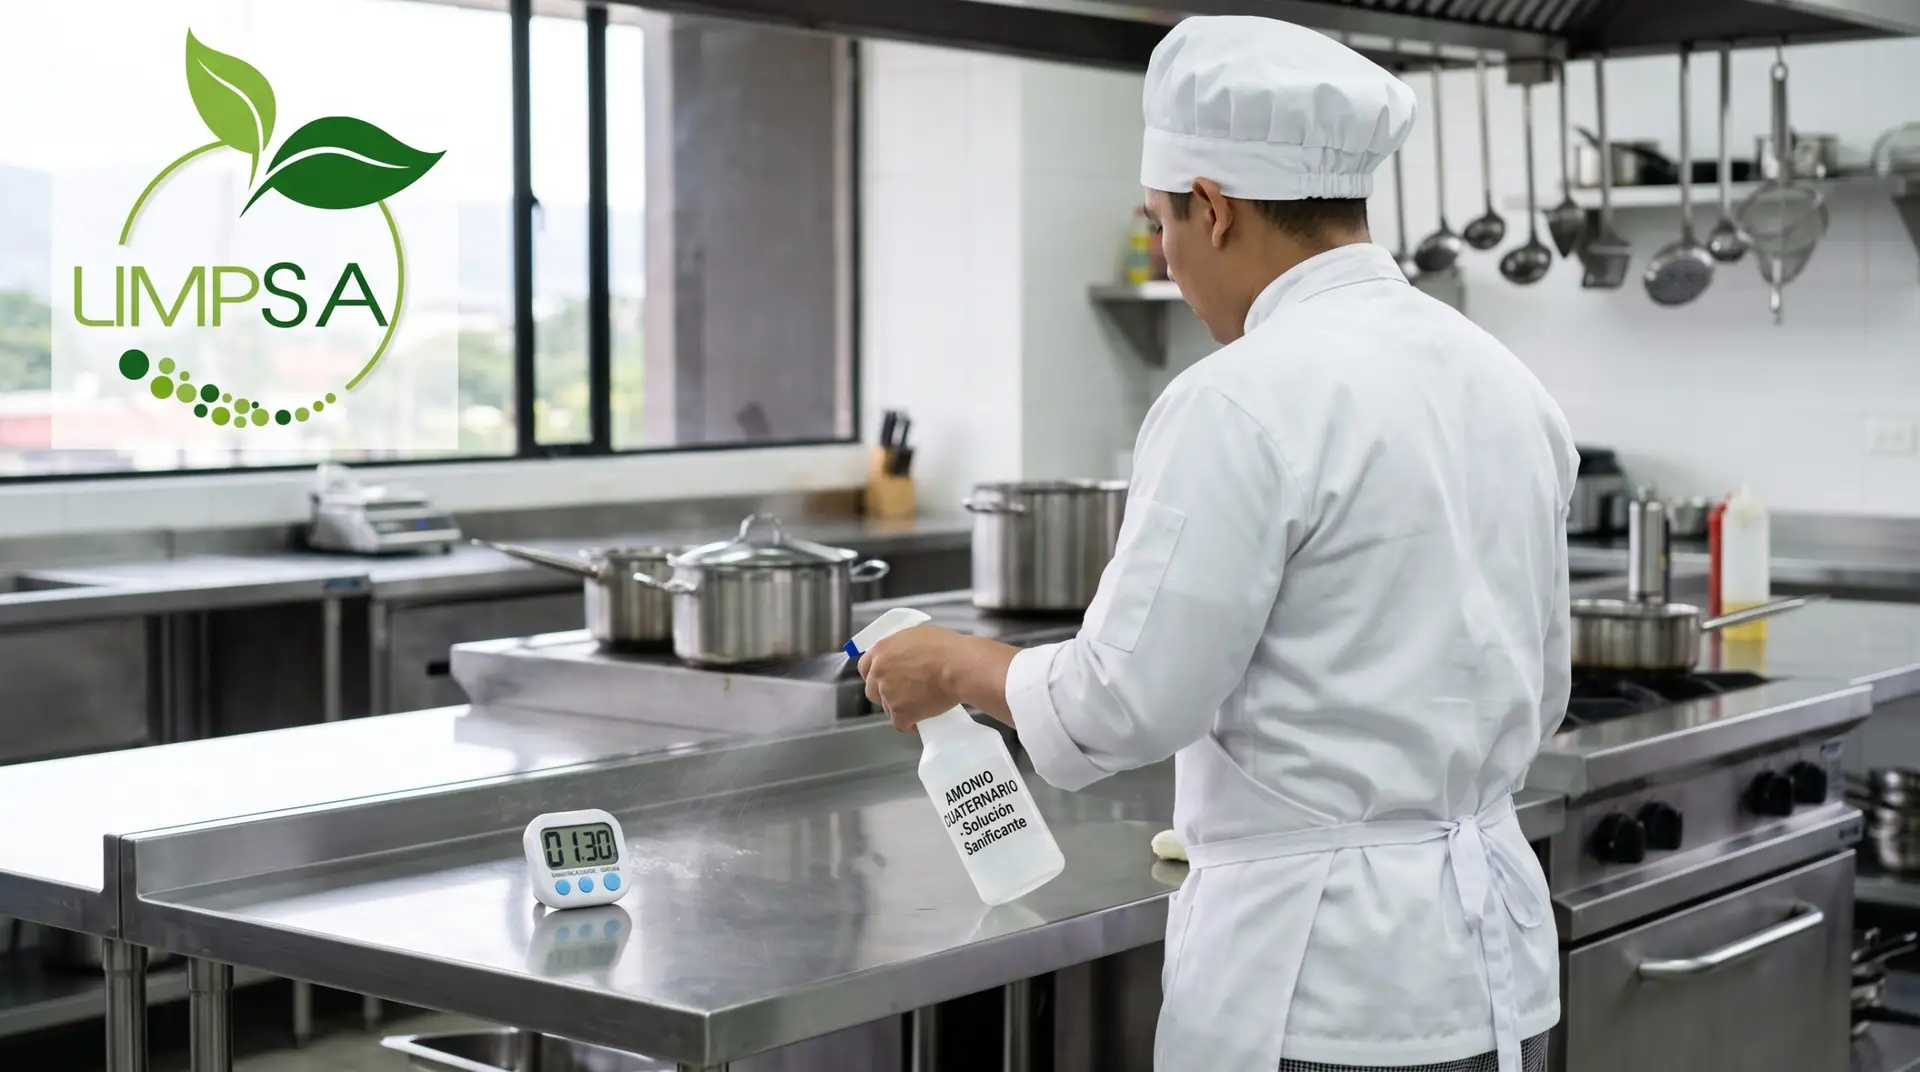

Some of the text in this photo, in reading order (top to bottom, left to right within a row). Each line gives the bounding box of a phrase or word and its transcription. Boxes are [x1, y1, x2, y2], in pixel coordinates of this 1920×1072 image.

[943, 779, 1018, 828] CUATERNARIO
[945, 770, 994, 806] AMONIO
[962, 803, 1015, 836] Solución
[964, 817, 1028, 856] Sanificante
